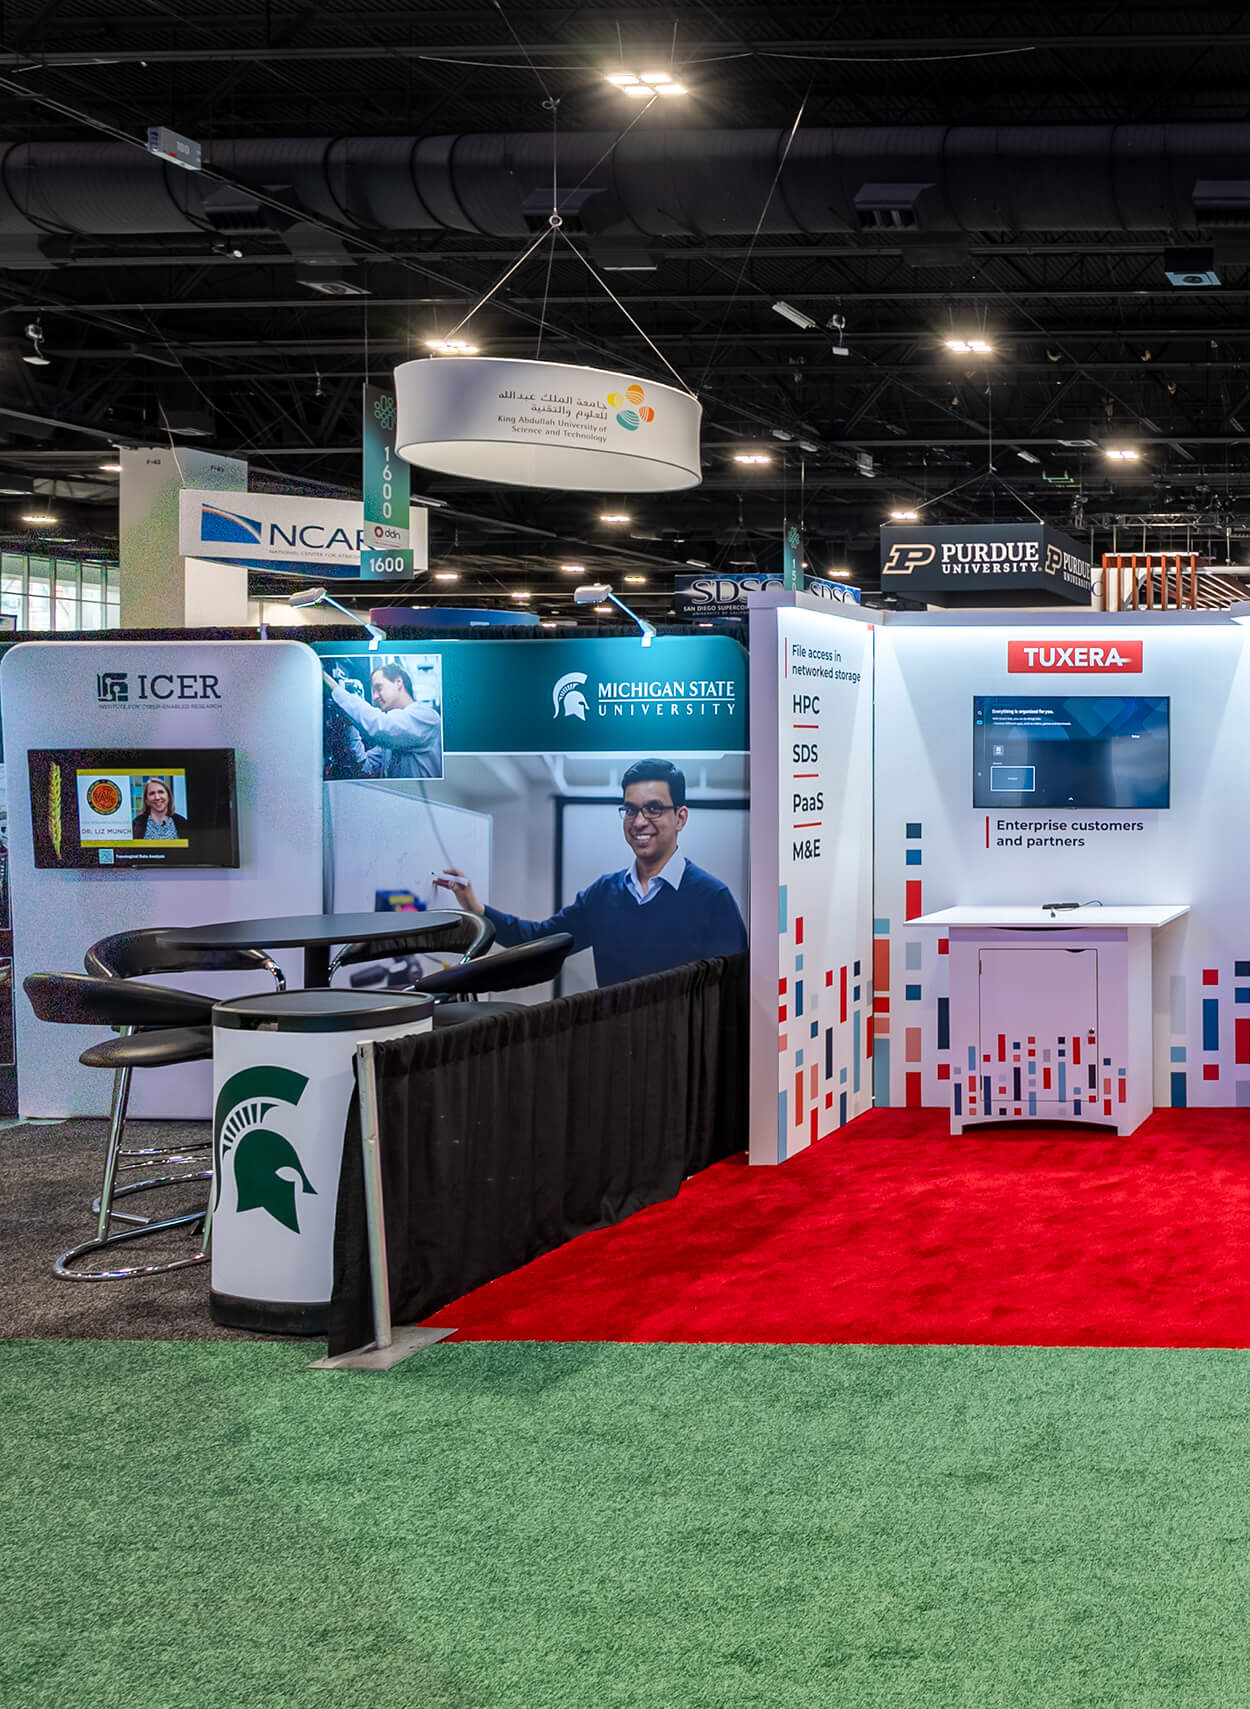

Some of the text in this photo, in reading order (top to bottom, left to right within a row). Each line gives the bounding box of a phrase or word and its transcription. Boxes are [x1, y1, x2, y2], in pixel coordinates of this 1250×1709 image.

[497, 415, 516, 424] King
[518, 415, 556, 427] Abdullah
[557, 420, 598, 433] University
[511, 425, 607, 444] Science and Technology
[381, 446, 393, 519] 1600
[384, 528, 401, 540] ddn
[941, 542, 1040, 564] PURDUE
[369, 557, 404, 572] 1600
[1063, 551, 1091, 580] PURDUE
[697, 604, 717, 612] DIEGO
[792, 644, 842, 662] File access in
[1023, 647, 1132, 667] TUXERA
[792, 664, 861, 686] networked storage
[138, 674, 222, 700] ICER
[598, 681, 735, 698] MICHIGAN STATE
[598, 703, 736, 716] UNIVERSITY
[792, 694, 821, 714] HPC
[792, 743, 819, 763] SDS
[793, 792, 824, 813] PaaS
[997, 819, 1144, 833] Enterprise customers
[792, 838, 822, 861] M&E
[997, 835, 1085, 848] and partners
